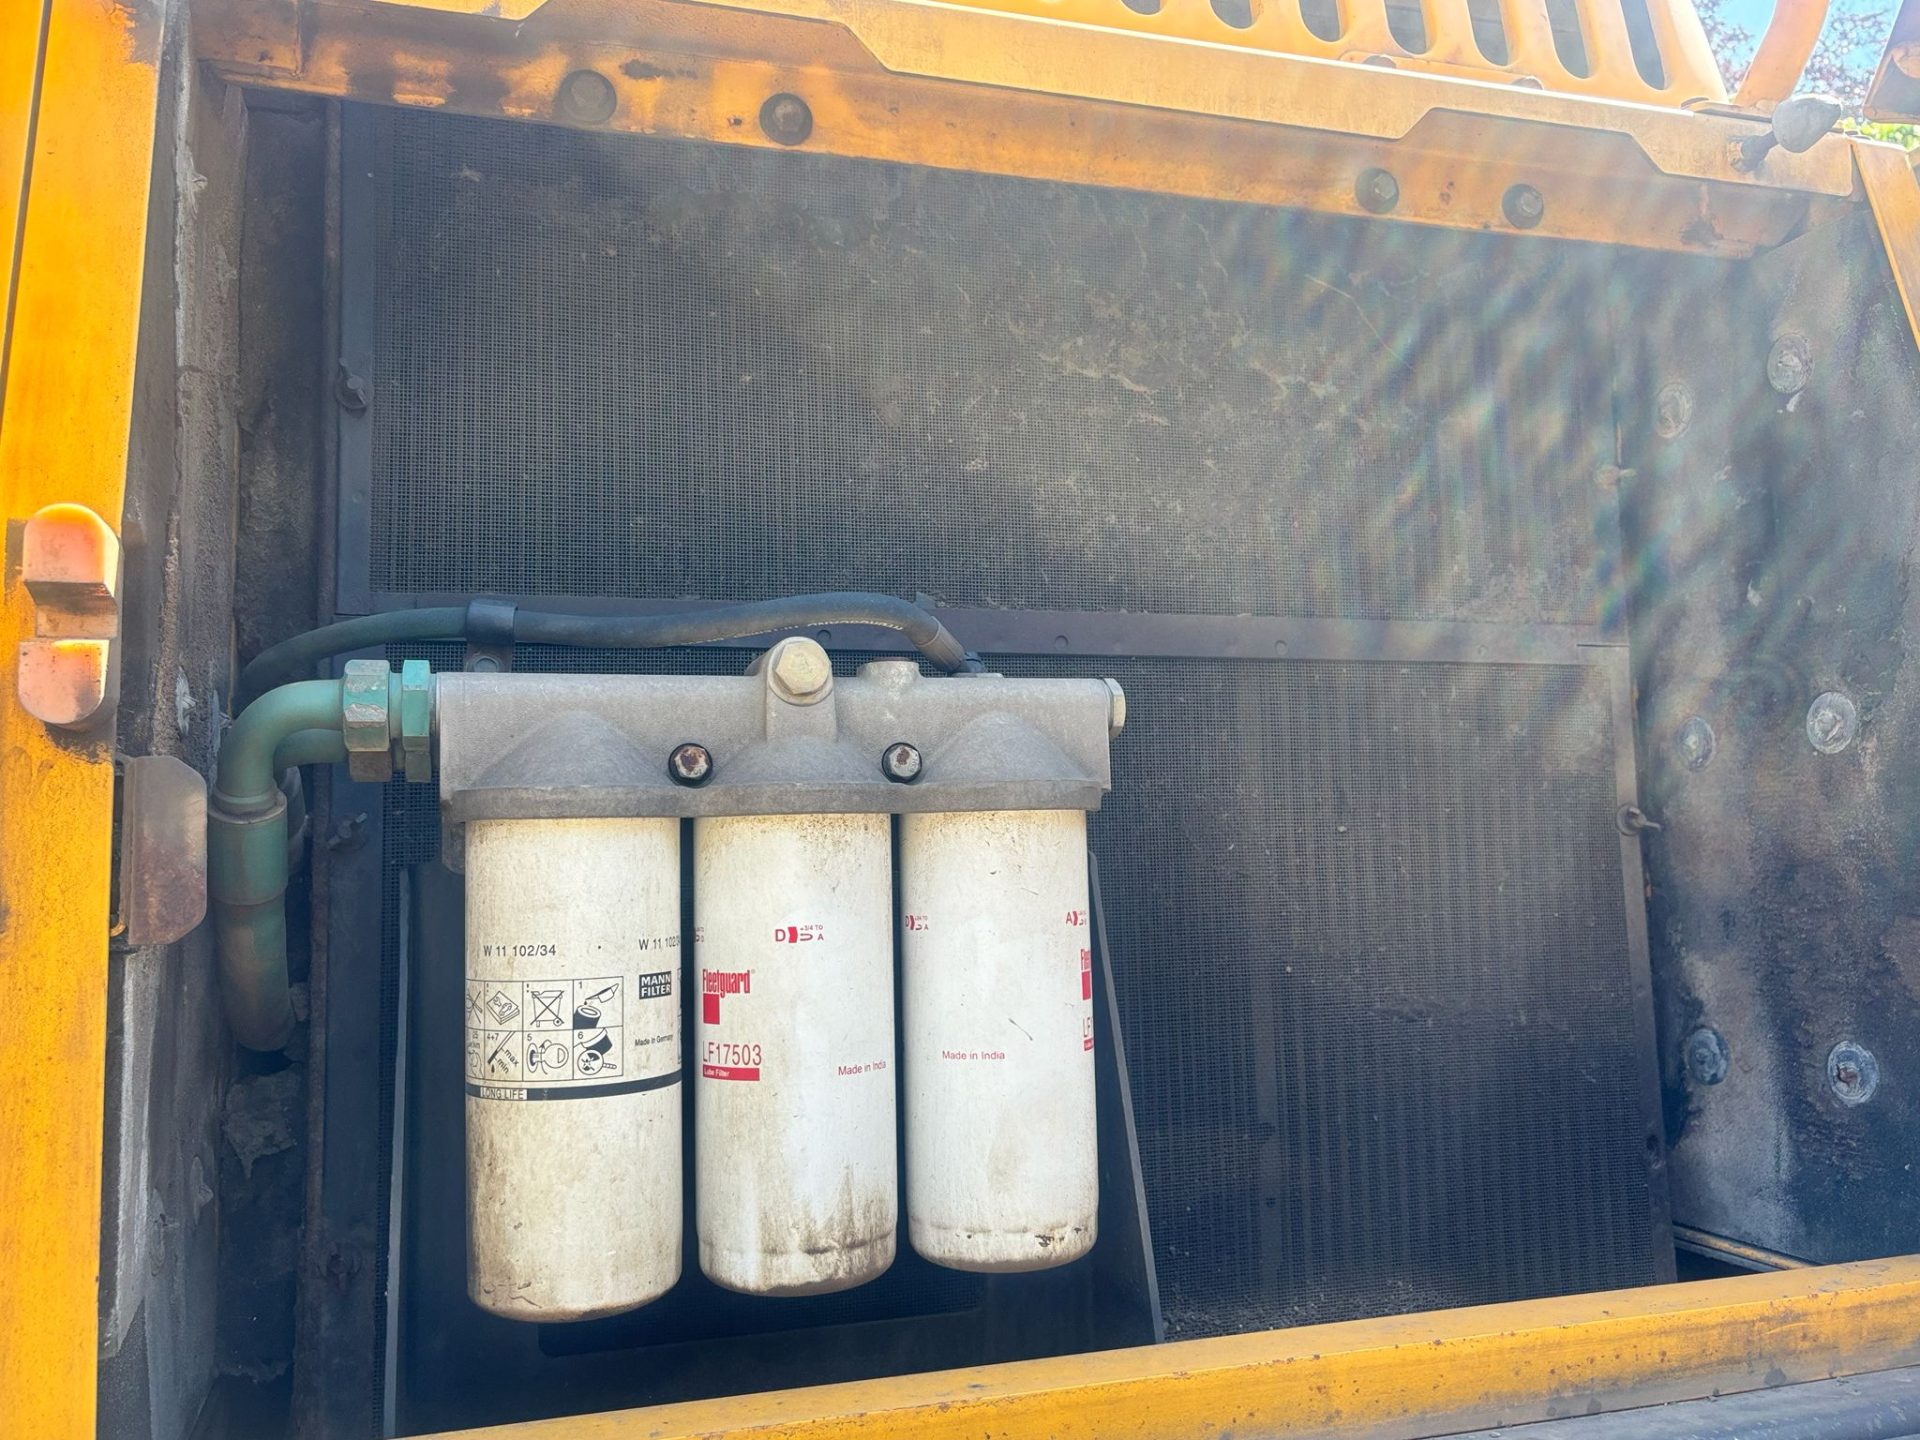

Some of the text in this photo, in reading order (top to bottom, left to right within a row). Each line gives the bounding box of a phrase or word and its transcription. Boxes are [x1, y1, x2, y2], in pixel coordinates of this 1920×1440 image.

[775, 929, 786, 942] D
[483, 944, 556, 957] W 11 102/34
[638, 938, 649, 951] W
[653, 937, 661, 950] 11
[641, 974, 671, 986] MANN
[703, 969, 750, 998] Fleetguard
[641, 984, 671, 997] FILTER
[487, 1032, 500, 1041] 4+7
[526, 1033, 533, 1041] 5
[577, 1031, 584, 1040] 6
[635, 1038, 650, 1046] Made
[504, 1048, 519, 1068] max
[703, 1040, 762, 1066] LF17503
[942, 1050, 1005, 1060] Made in India
[497, 1058, 510, 1074] min
[838, 1064, 863, 1076] Made
[864, 1064, 871, 1073] in
[481, 1087, 524, 1100] LONG LIFE
